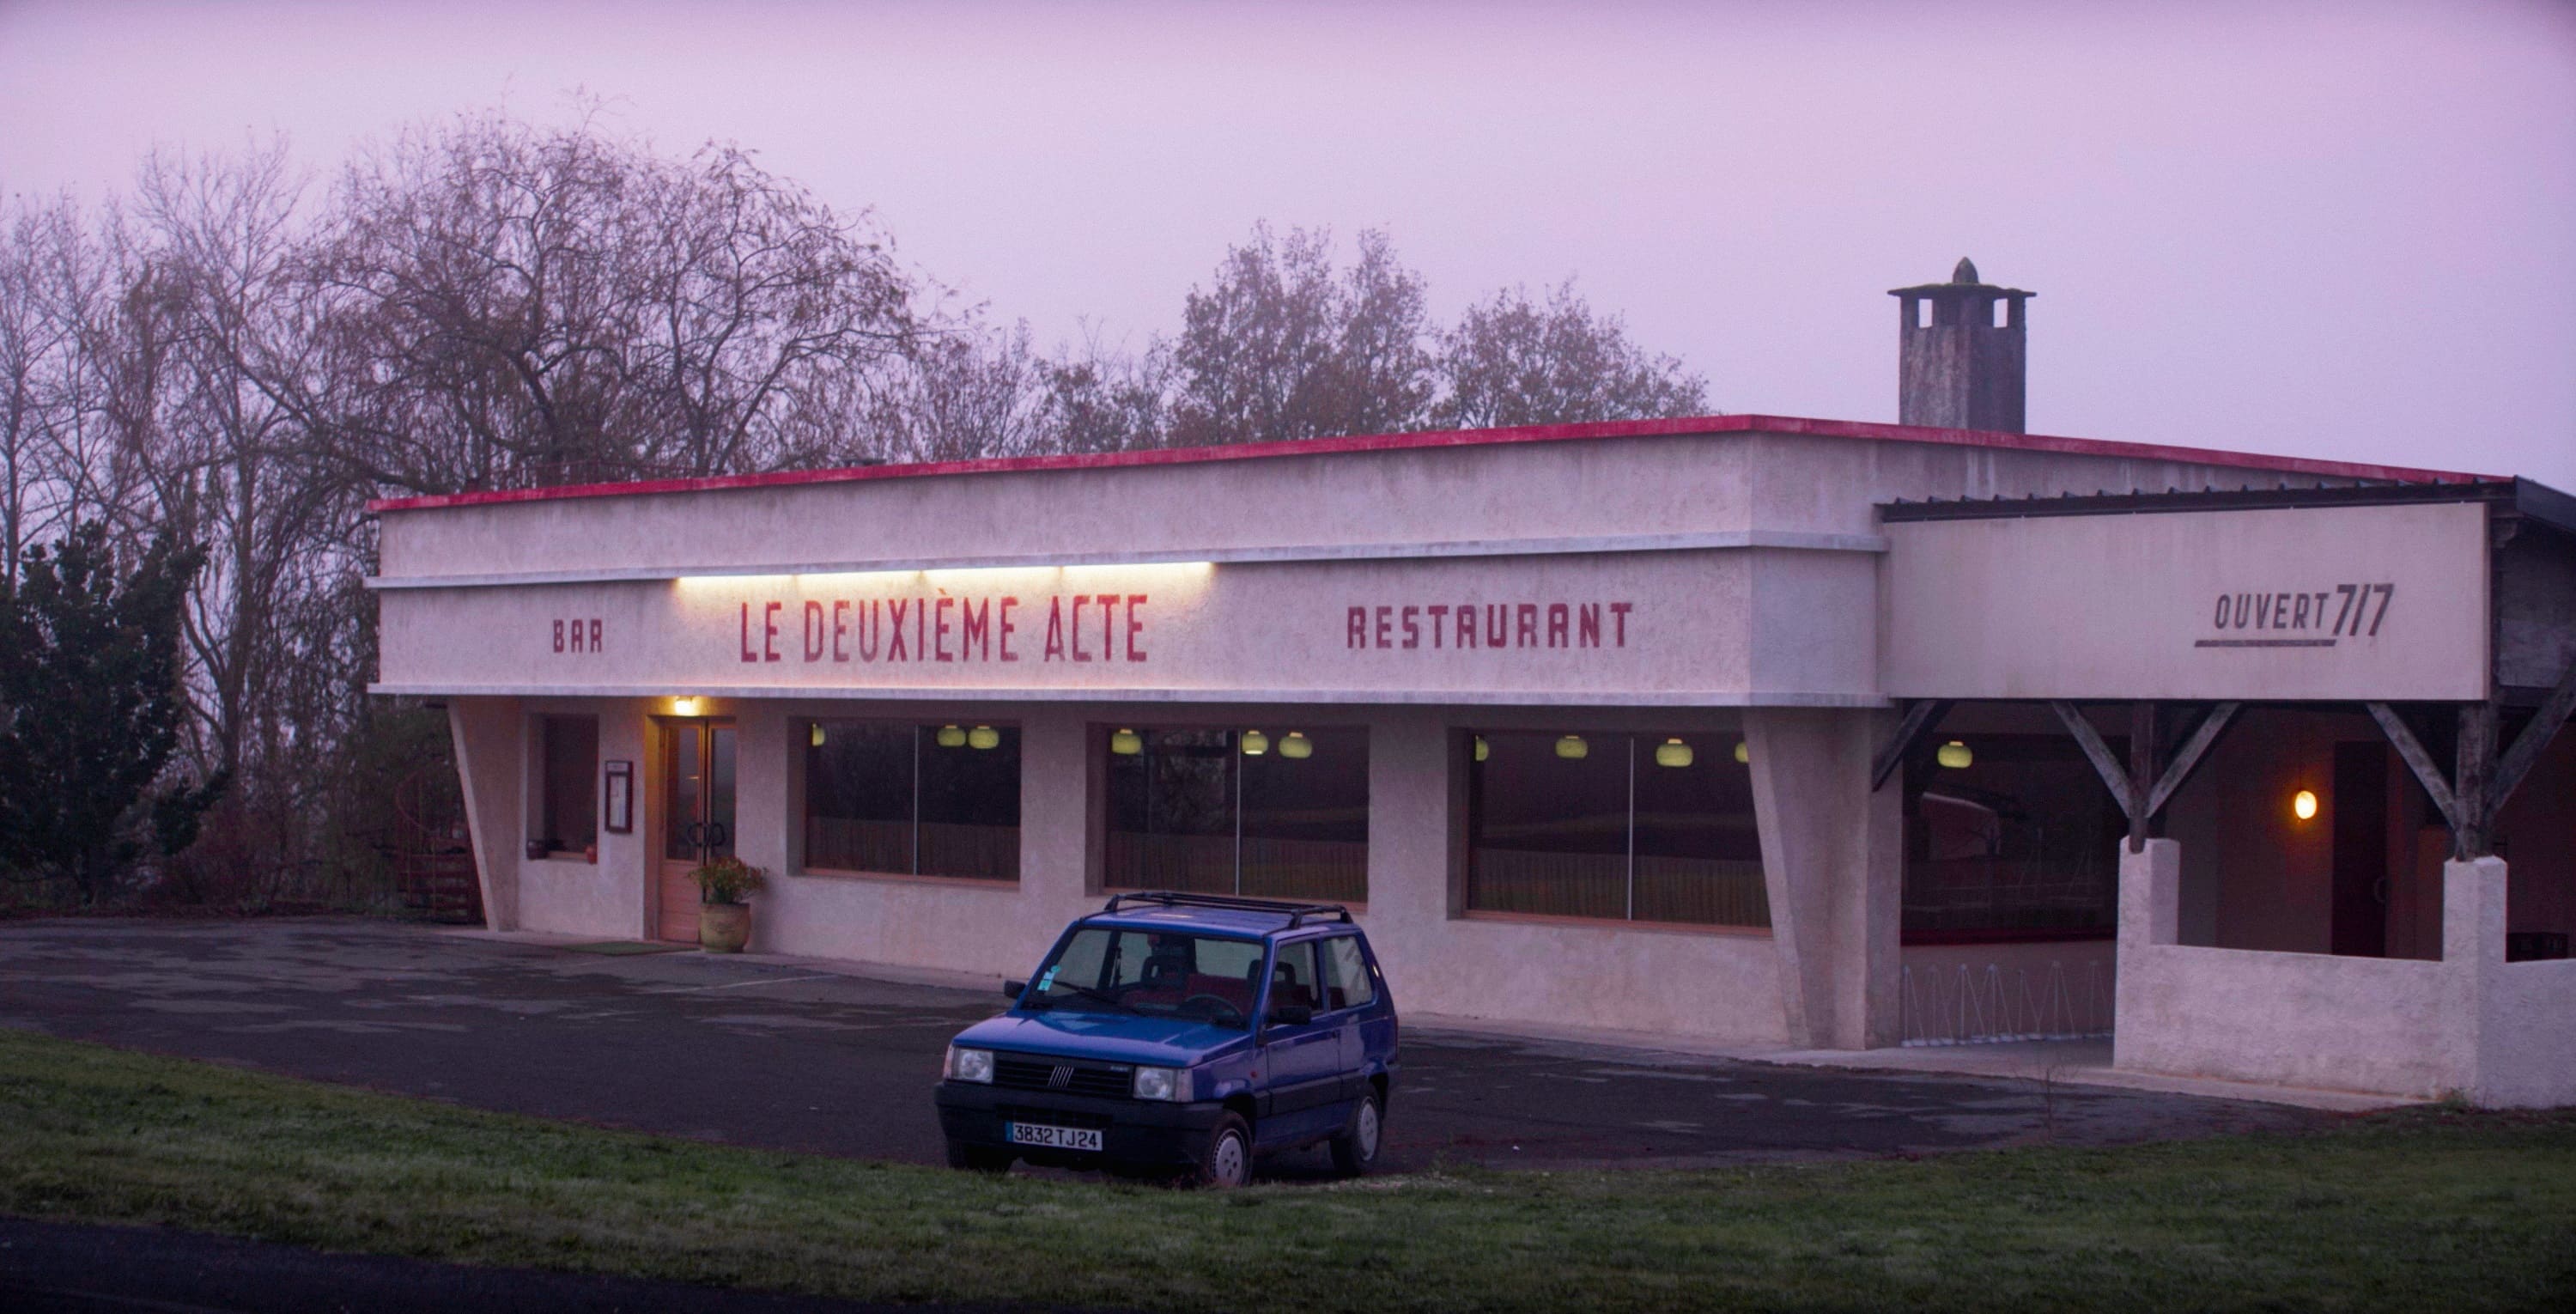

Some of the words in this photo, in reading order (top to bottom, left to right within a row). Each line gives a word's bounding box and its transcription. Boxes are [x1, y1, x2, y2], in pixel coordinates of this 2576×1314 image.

[739, 601, 782, 663] LE
[804, 589, 1019, 663] DEUXIÈME
[1044, 594, 1149, 662] ACTE
[1346, 602, 1632, 649] RESTAURANT
[2214, 593, 2330, 630] OUVERT
[2332, 583, 2394, 636] 7/7
[553, 619, 602, 653] BAR
